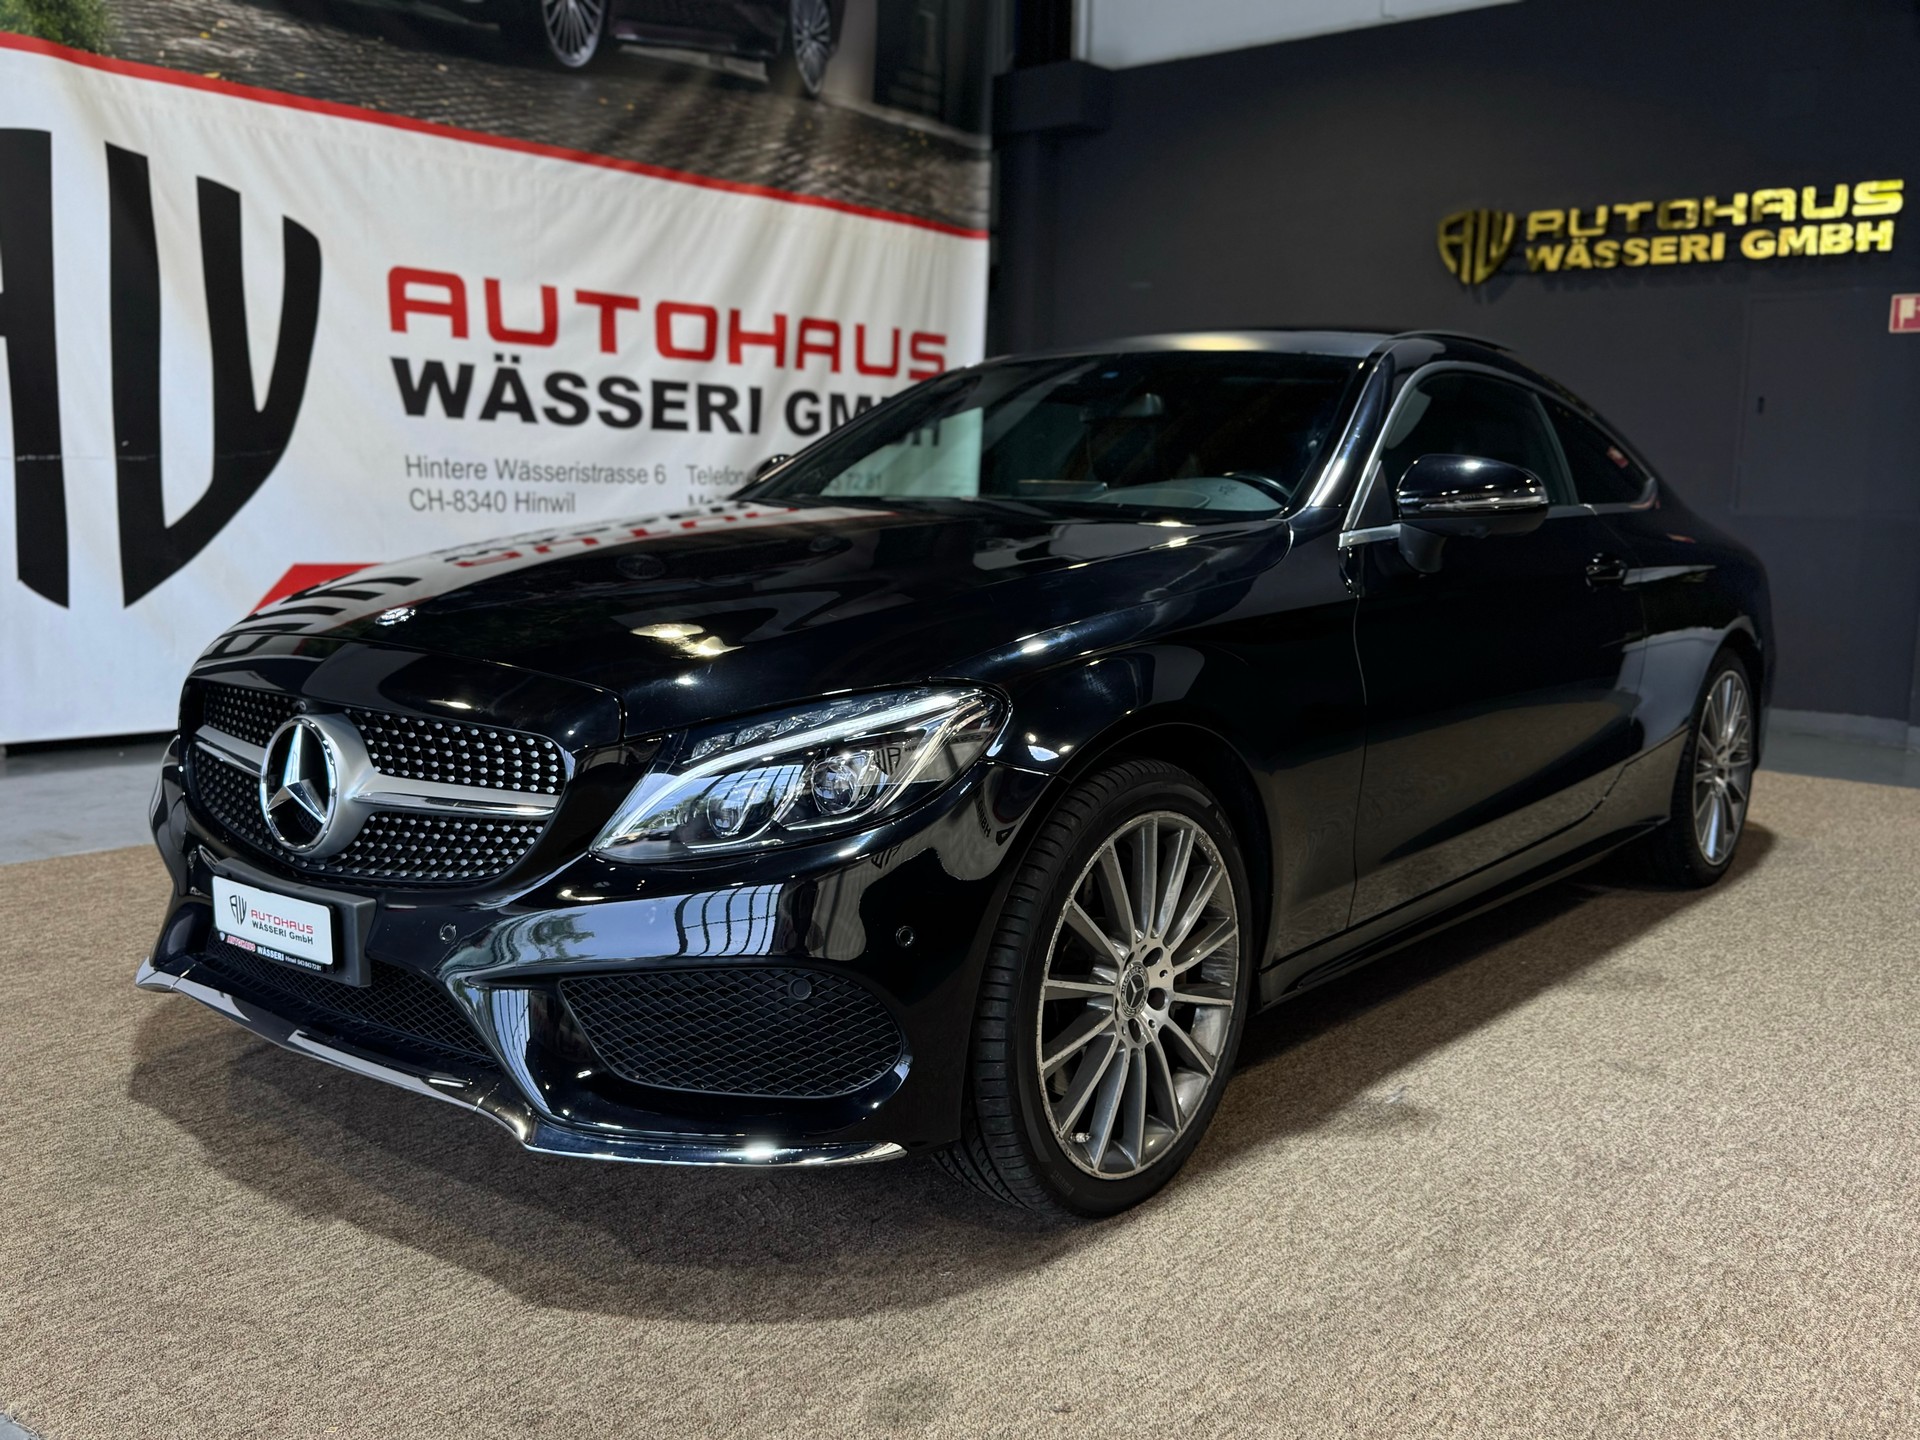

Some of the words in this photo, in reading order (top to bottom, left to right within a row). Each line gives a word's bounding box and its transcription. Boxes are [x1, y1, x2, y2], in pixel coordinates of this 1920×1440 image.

[1526, 179, 1904, 239] AUTOHAUS
[1526, 232, 1726, 272] WÄSSERI
[1740, 221, 1895, 260] GMBH
[388, 266, 947, 381] AUTOHAUS
[391, 354, 763, 435] WÄSSERI
[405, 455, 487, 480] Hintere
[495, 458, 648, 484] Wässeristrasse
[653, 463, 667, 485] 6
[409, 487, 507, 513] CH-8340
[515, 492, 576, 513] Hinwil
[251, 909, 314, 934] AUTOHAUS
[252, 920, 287, 938] WÄSSERI
[288, 931, 314, 945] GmbH
